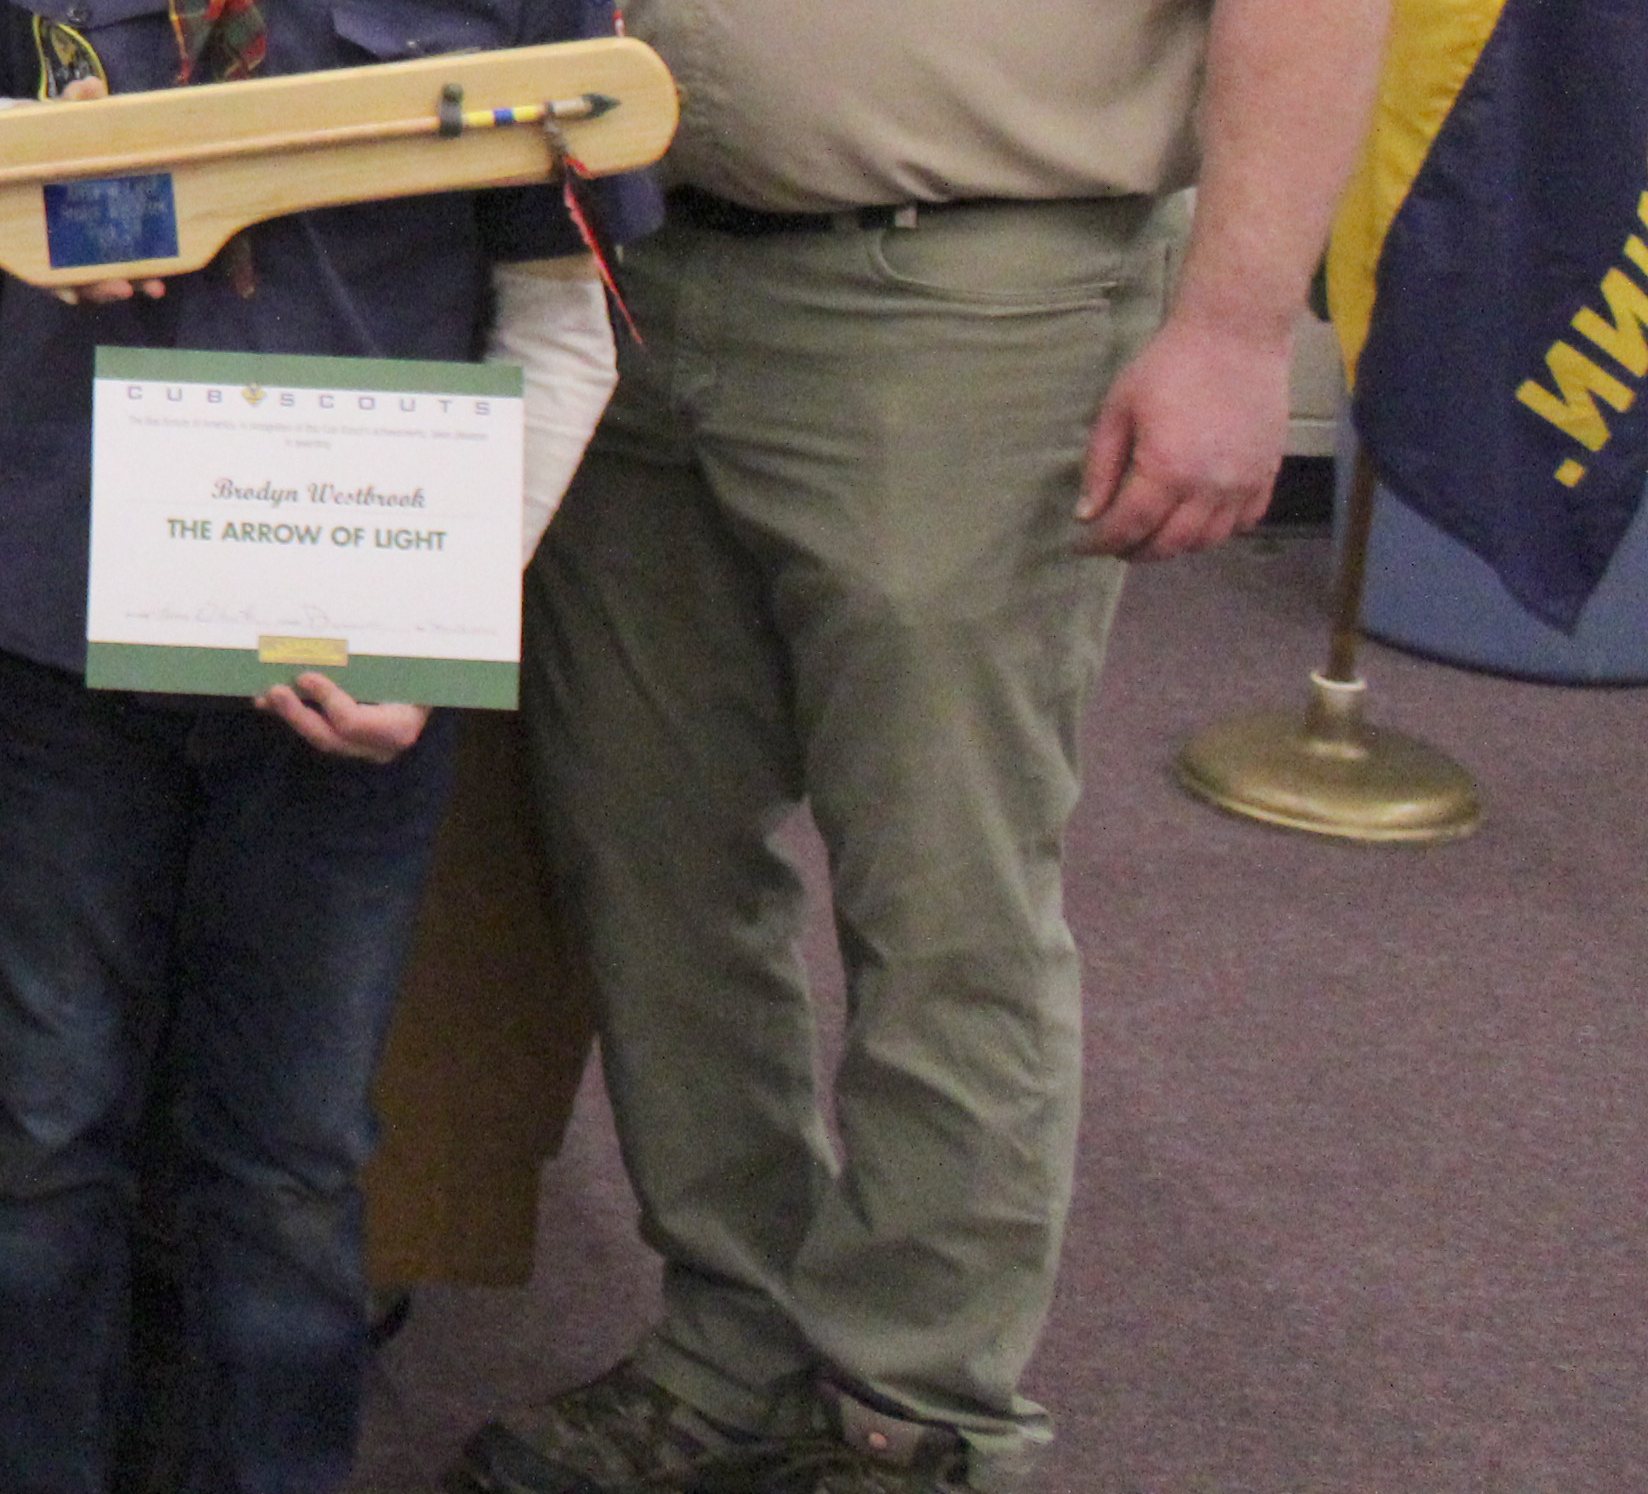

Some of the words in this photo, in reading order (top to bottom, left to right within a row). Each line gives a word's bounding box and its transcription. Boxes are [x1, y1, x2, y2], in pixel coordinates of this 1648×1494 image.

[127, 385, 223, 405] CUB
[280, 392, 490, 416] SCOUTS
[306, 482, 426, 509] Westbrook
[167, 518, 212, 541] THE
[221, 521, 323, 546] ARROW
[331, 526, 366, 547] OF
[374, 527, 447, 552] LIGHT
